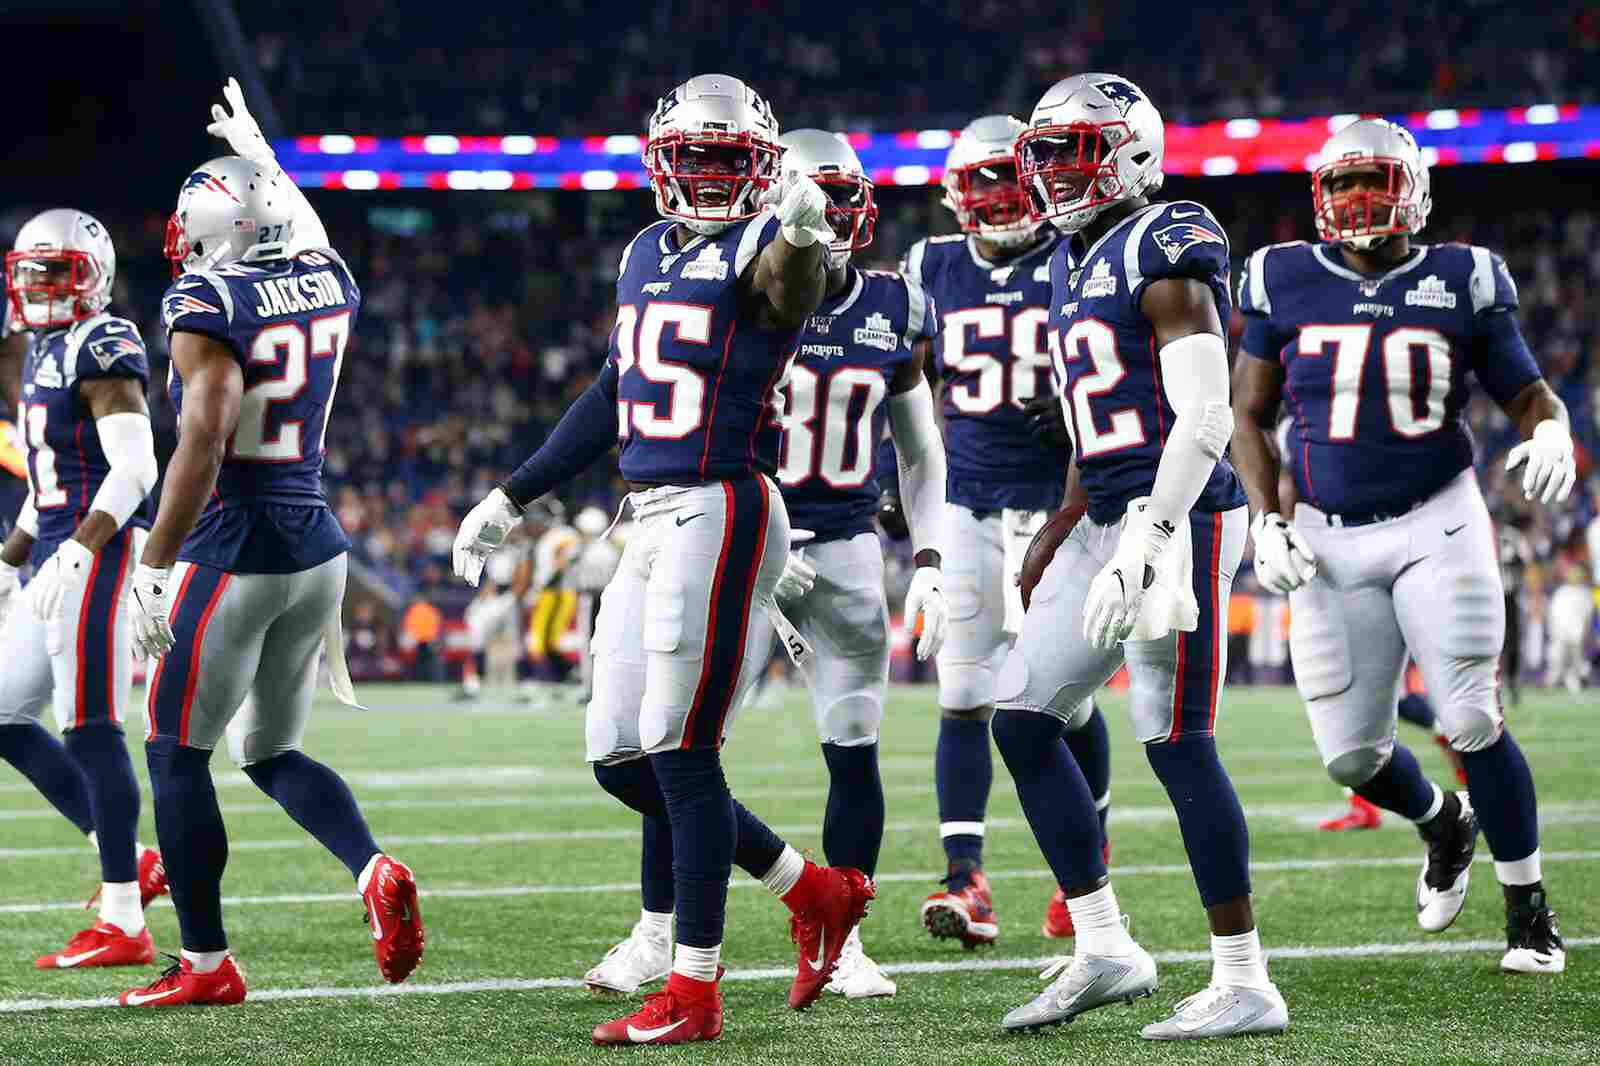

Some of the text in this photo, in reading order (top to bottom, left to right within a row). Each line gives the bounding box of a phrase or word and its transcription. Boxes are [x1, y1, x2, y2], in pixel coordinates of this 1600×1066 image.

[259, 224, 283, 243] 27
[253, 271, 346, 318] JACKSON
[801, 344, 844, 360] PATRIOTS
[232, 311, 352, 462] 27
[1297, 323, 1451, 441] 70
